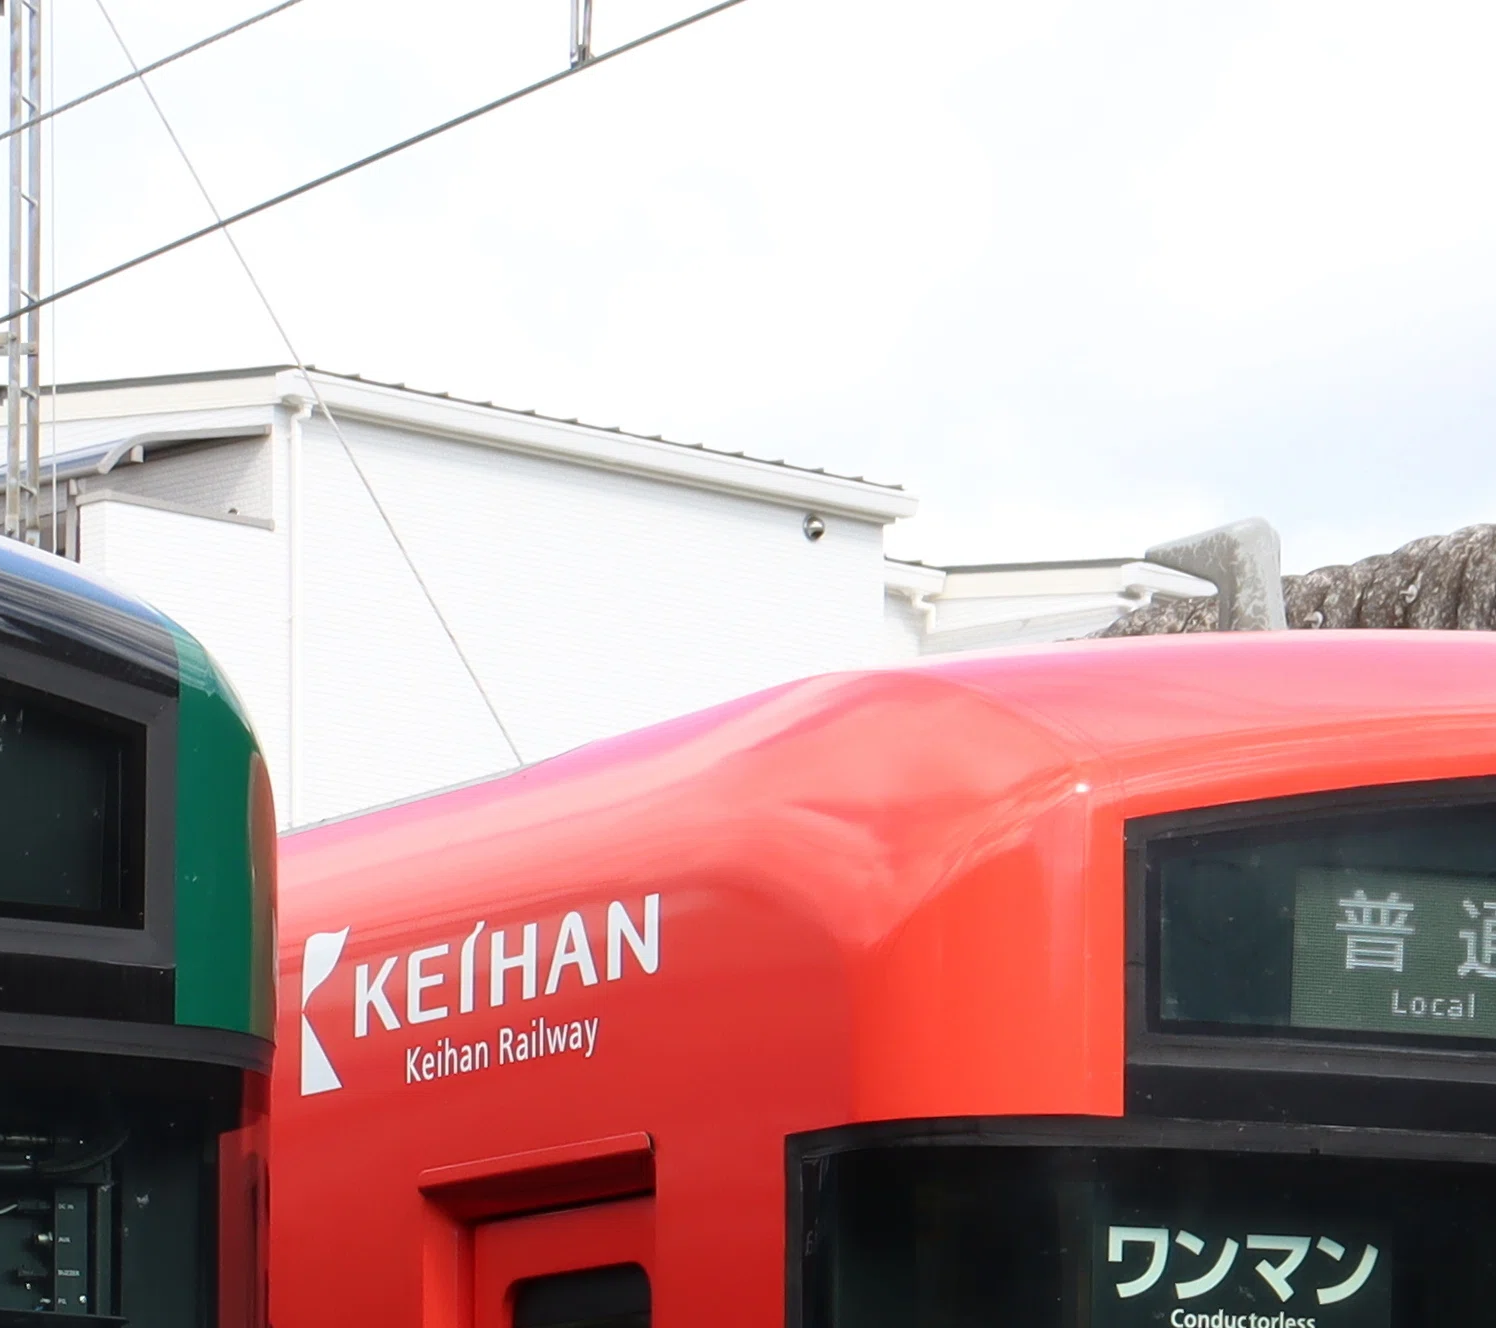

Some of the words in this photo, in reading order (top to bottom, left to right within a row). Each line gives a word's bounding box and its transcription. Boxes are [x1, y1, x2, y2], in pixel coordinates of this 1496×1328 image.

[354, 893, 660, 1039] KEIHAN
[1390, 988, 1477, 1019] Local
[406, 1038, 489, 1084] Keihan
[499, 1017, 599, 1063] Railway
[1108, 1225, 1379, 1306] ワンマン
